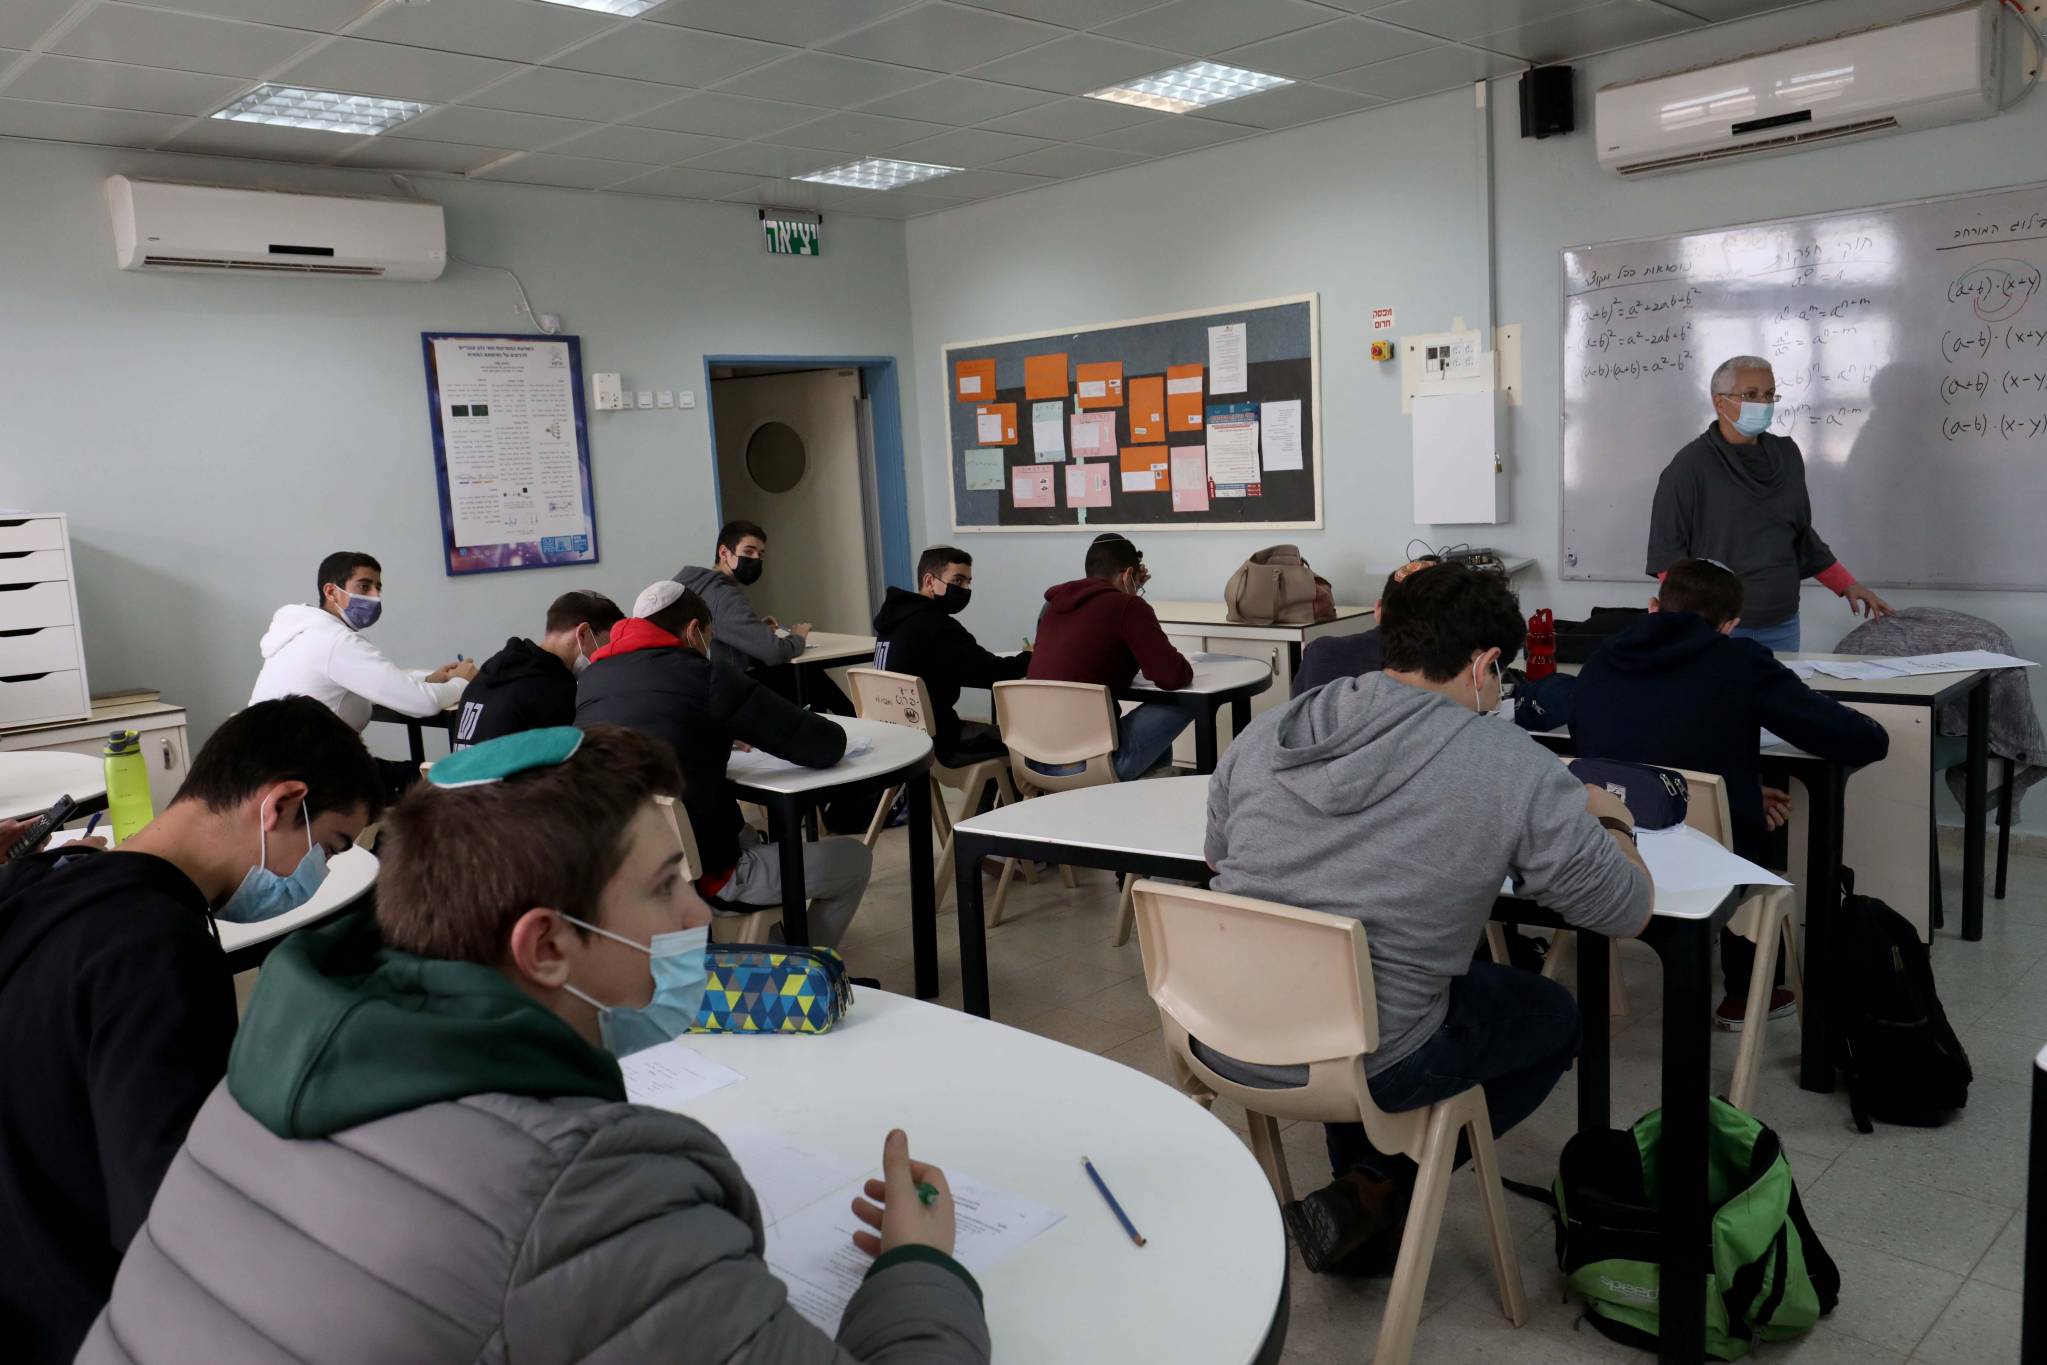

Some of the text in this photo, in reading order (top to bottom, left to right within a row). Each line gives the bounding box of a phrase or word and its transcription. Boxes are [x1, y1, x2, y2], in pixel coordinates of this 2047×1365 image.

[766, 220, 817, 255] יציאה
[1372, 308, 1393, 319] מפסק
[1374, 319, 1391, 328] חרום
